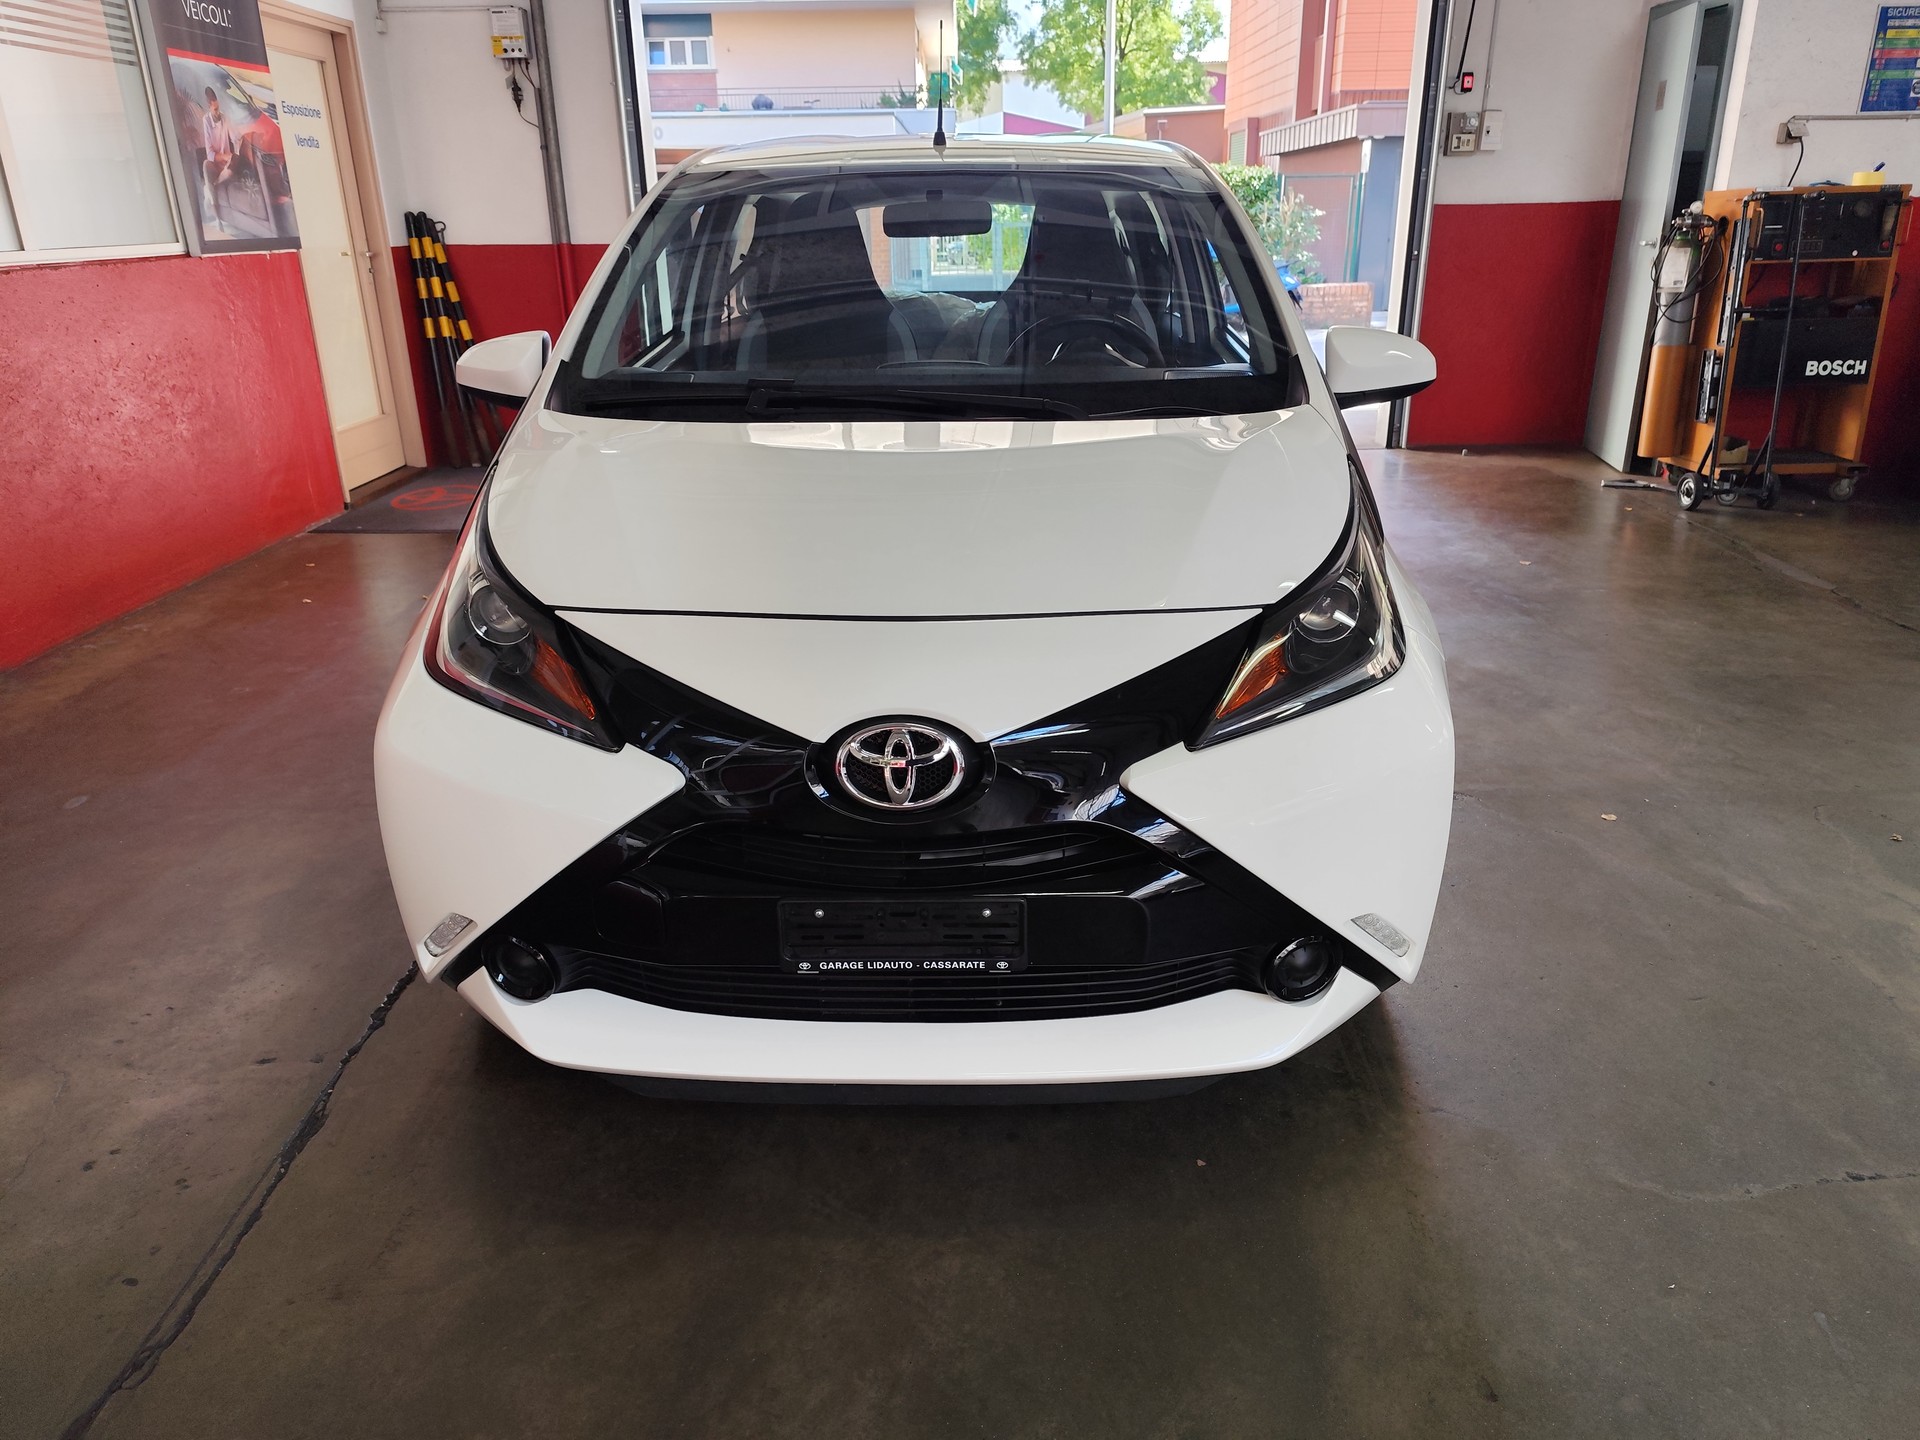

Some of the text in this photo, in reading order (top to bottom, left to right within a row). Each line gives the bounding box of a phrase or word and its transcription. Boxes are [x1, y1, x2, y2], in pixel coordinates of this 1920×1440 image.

[281, 100, 322, 119] Esposizione
[294, 133, 320, 149] Vendita
[1805, 359, 1868, 376] BOSCH
[819, 961, 864, 970] GARAGE
[867, 961, 913, 969] LIDAUTO
[923, 961, 986, 969] CASSARATE
